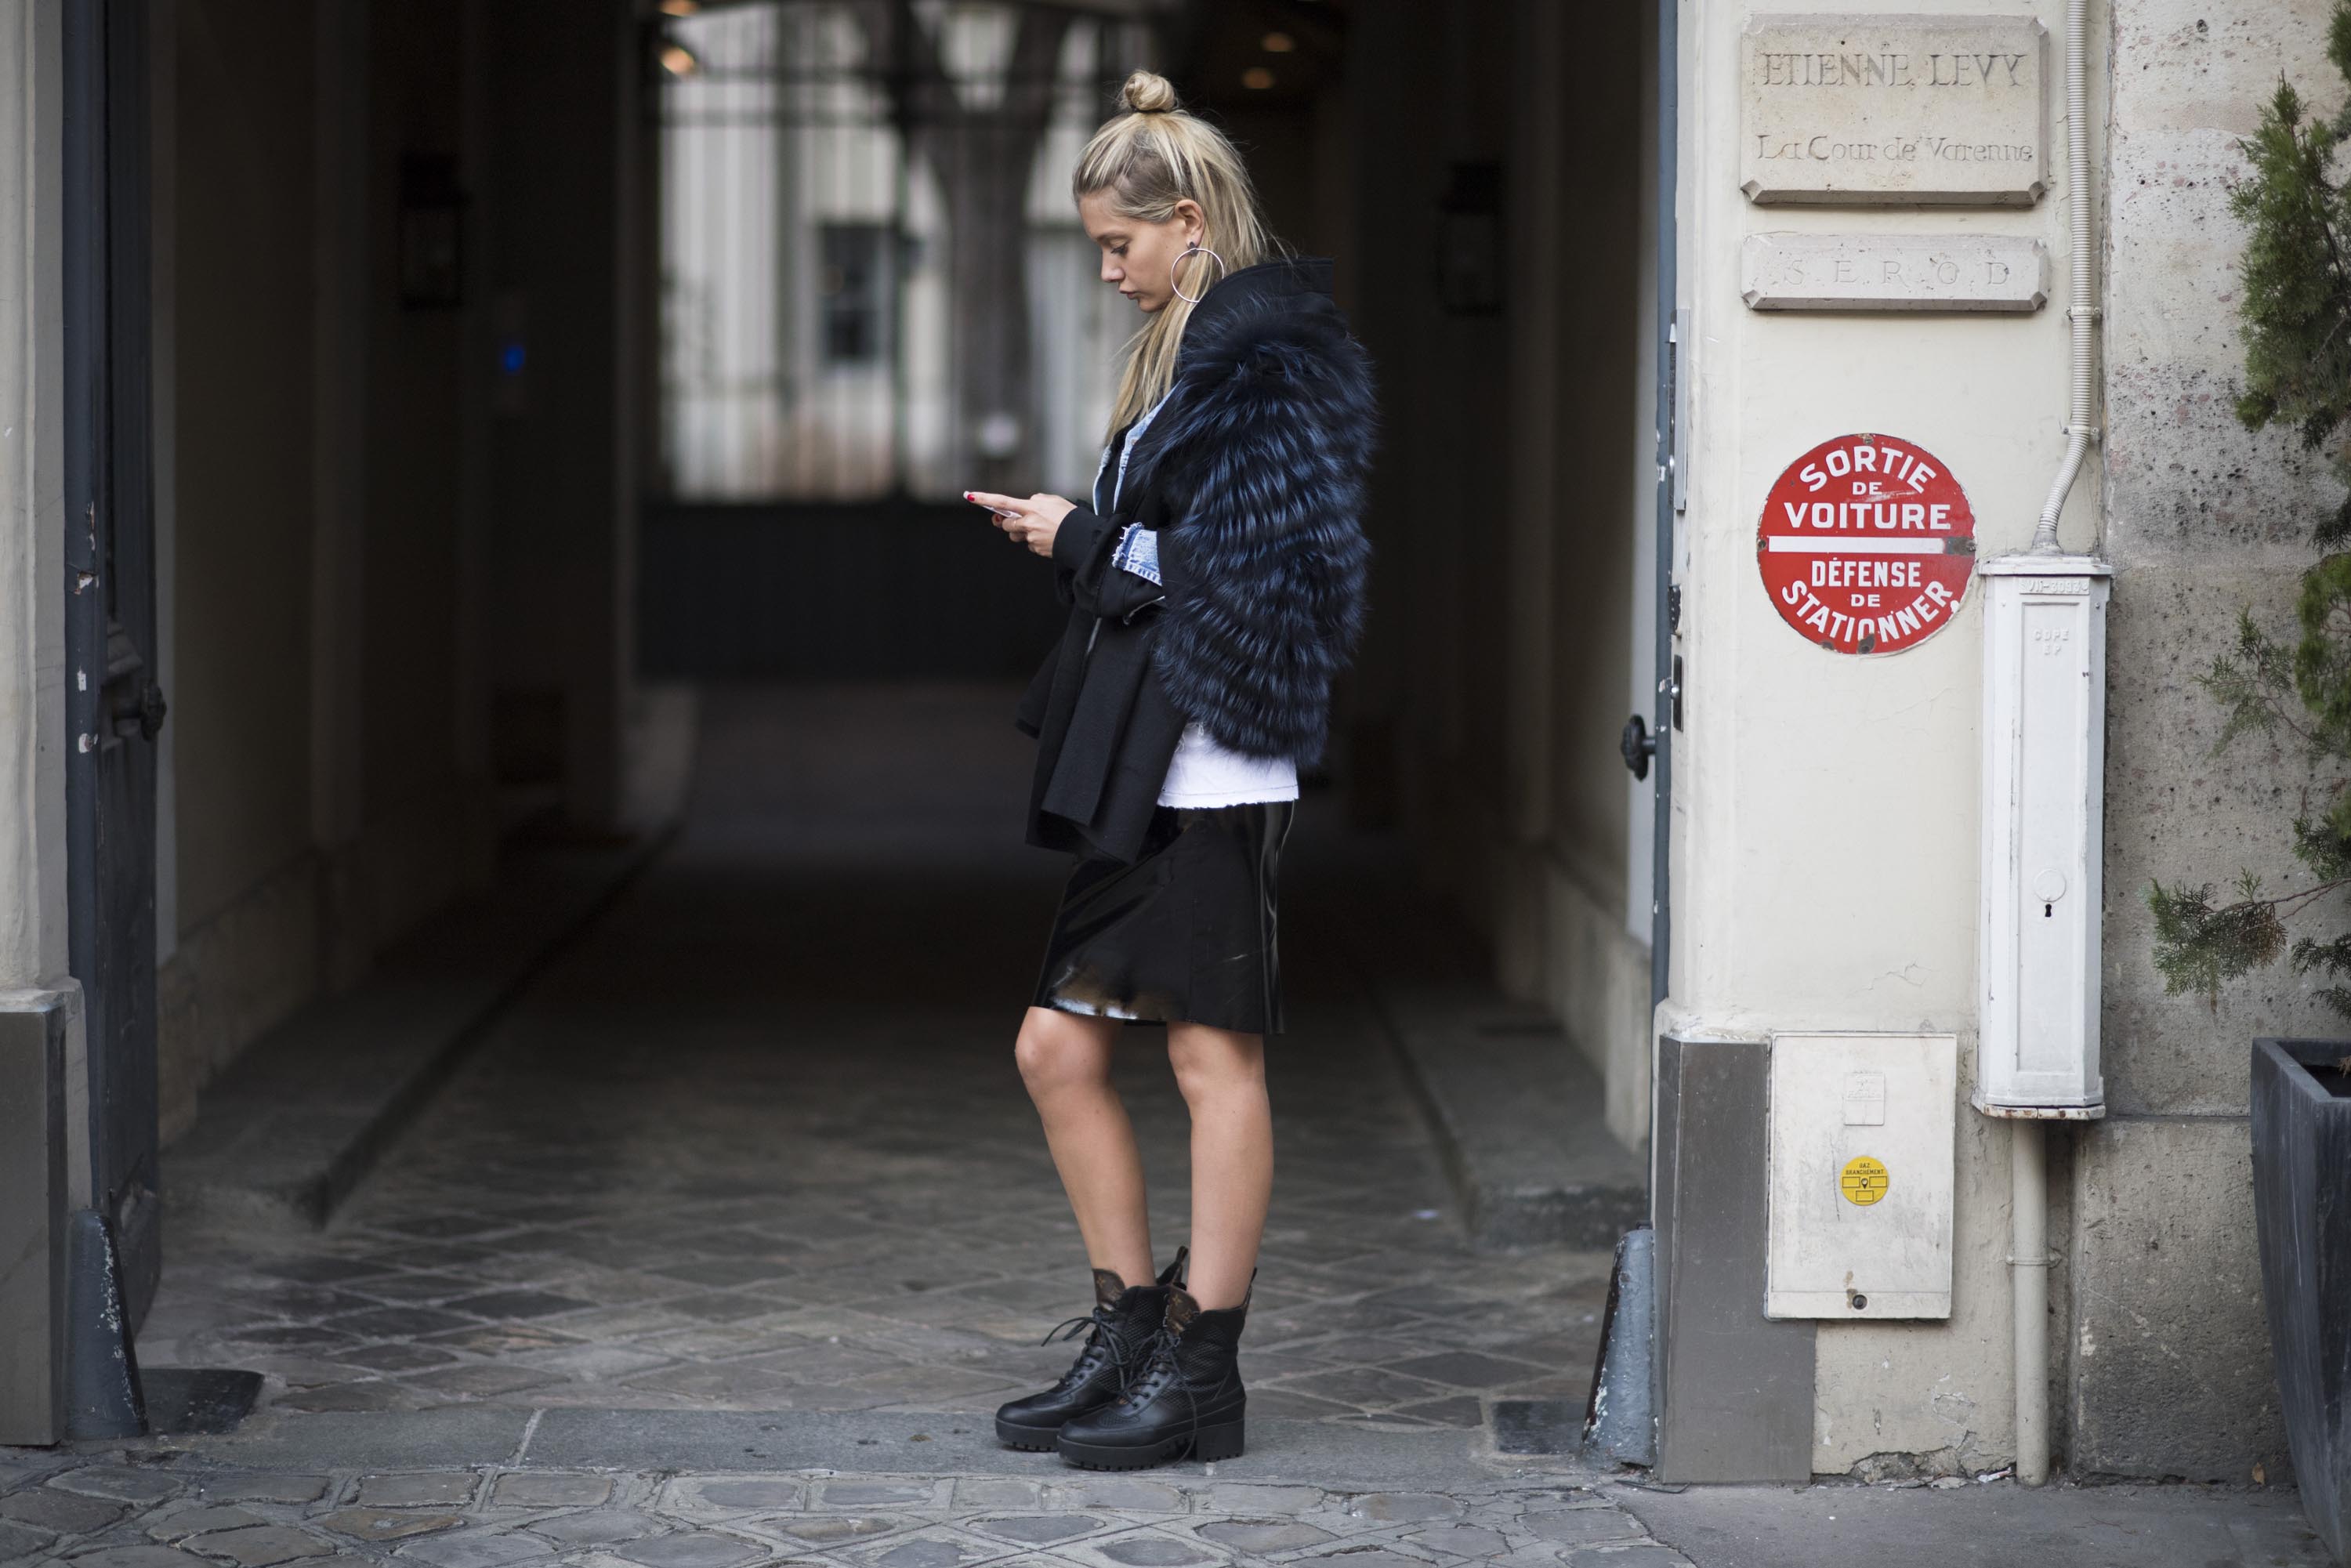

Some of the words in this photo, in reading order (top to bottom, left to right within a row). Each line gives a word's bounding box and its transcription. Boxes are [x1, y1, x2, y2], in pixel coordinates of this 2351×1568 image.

[1928, 53, 2028, 87] LEVY
[1756, 134, 1805, 160] La
[1808, 135, 1878, 161] Cour
[1926, 137, 2034, 162] Varenne
[1799, 445, 1936, 494] SORTIE
[1852, 481, 1882, 495] DE
[1784, 502, 1951, 530] VOITURE
[1811, 557, 1921, 588] DÉFENSE
[1781, 580, 1953, 643] STATIONNER
[1850, 593, 1881, 607] DE
